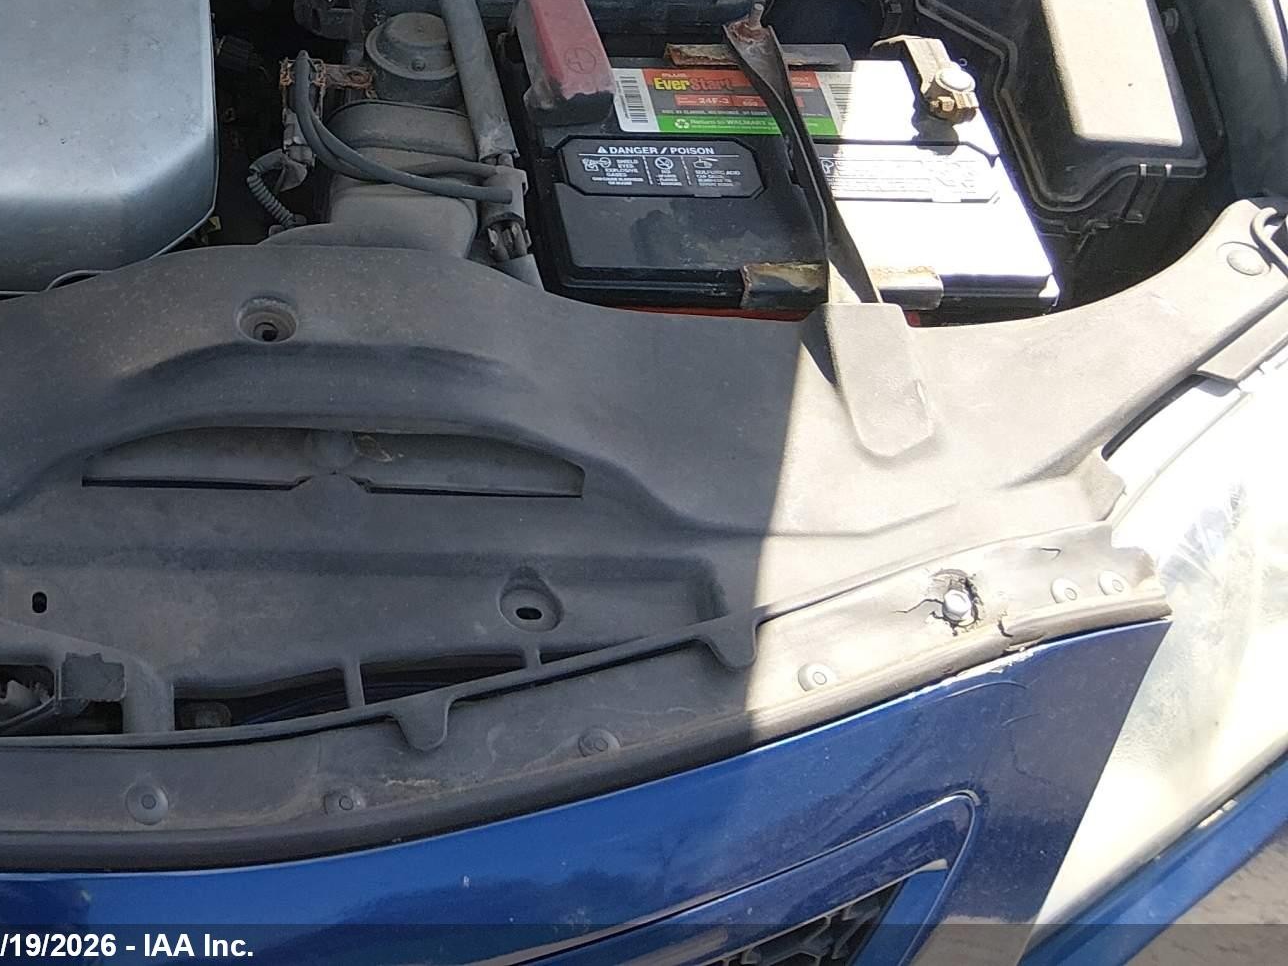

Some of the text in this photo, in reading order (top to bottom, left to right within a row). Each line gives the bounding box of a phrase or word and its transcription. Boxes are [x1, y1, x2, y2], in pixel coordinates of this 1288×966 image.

[654, 77, 731, 91] EverStart
[609, 146, 657, 154] DANGER
[670, 147, 715, 155] POISON
